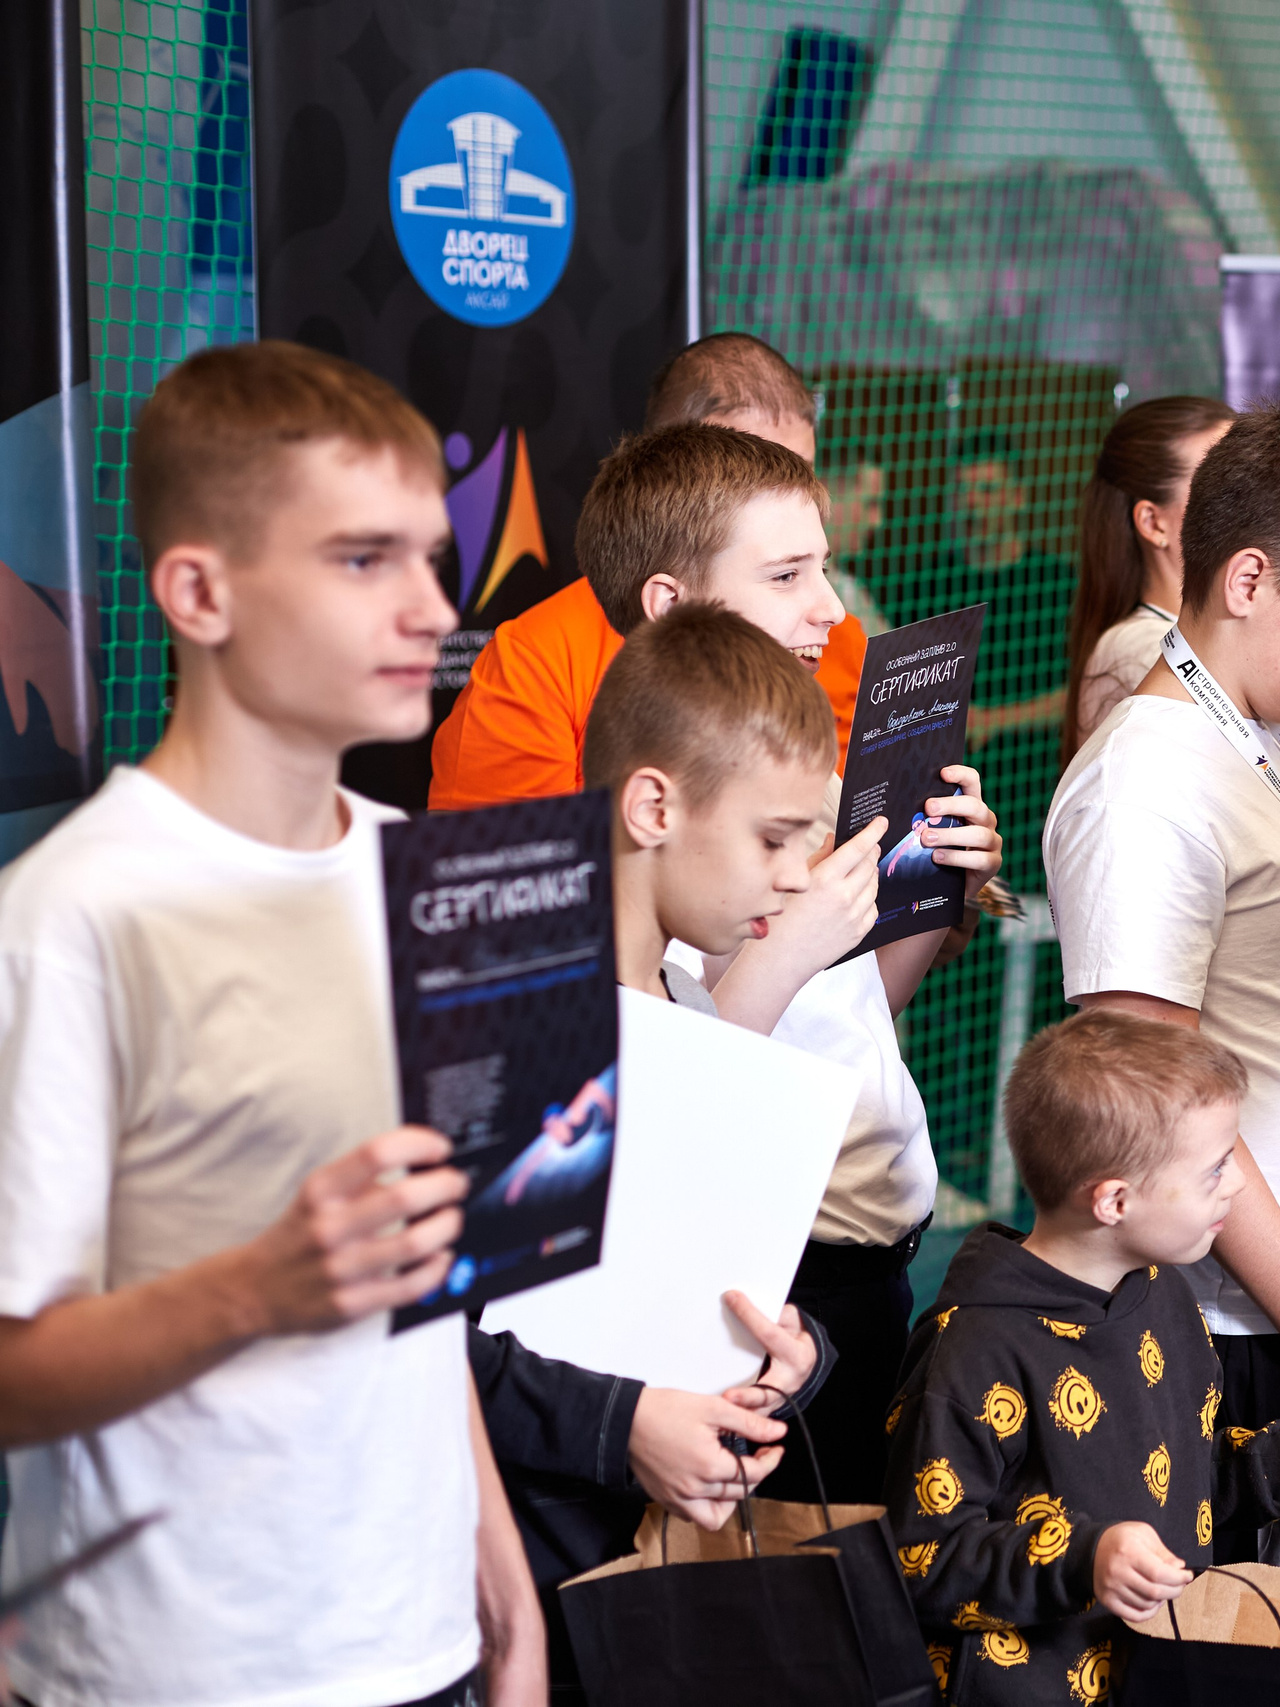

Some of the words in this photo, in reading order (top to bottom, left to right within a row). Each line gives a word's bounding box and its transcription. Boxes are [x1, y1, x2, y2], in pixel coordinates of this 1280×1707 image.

[442, 229, 530, 262] ДВОРЕЦ
[442, 257, 530, 291] СПОРТА
[870, 655, 966, 705] СЕРТИФИКАТ
[1189, 679, 1228, 727] компания
[1197, 671, 1251, 739] строительная
